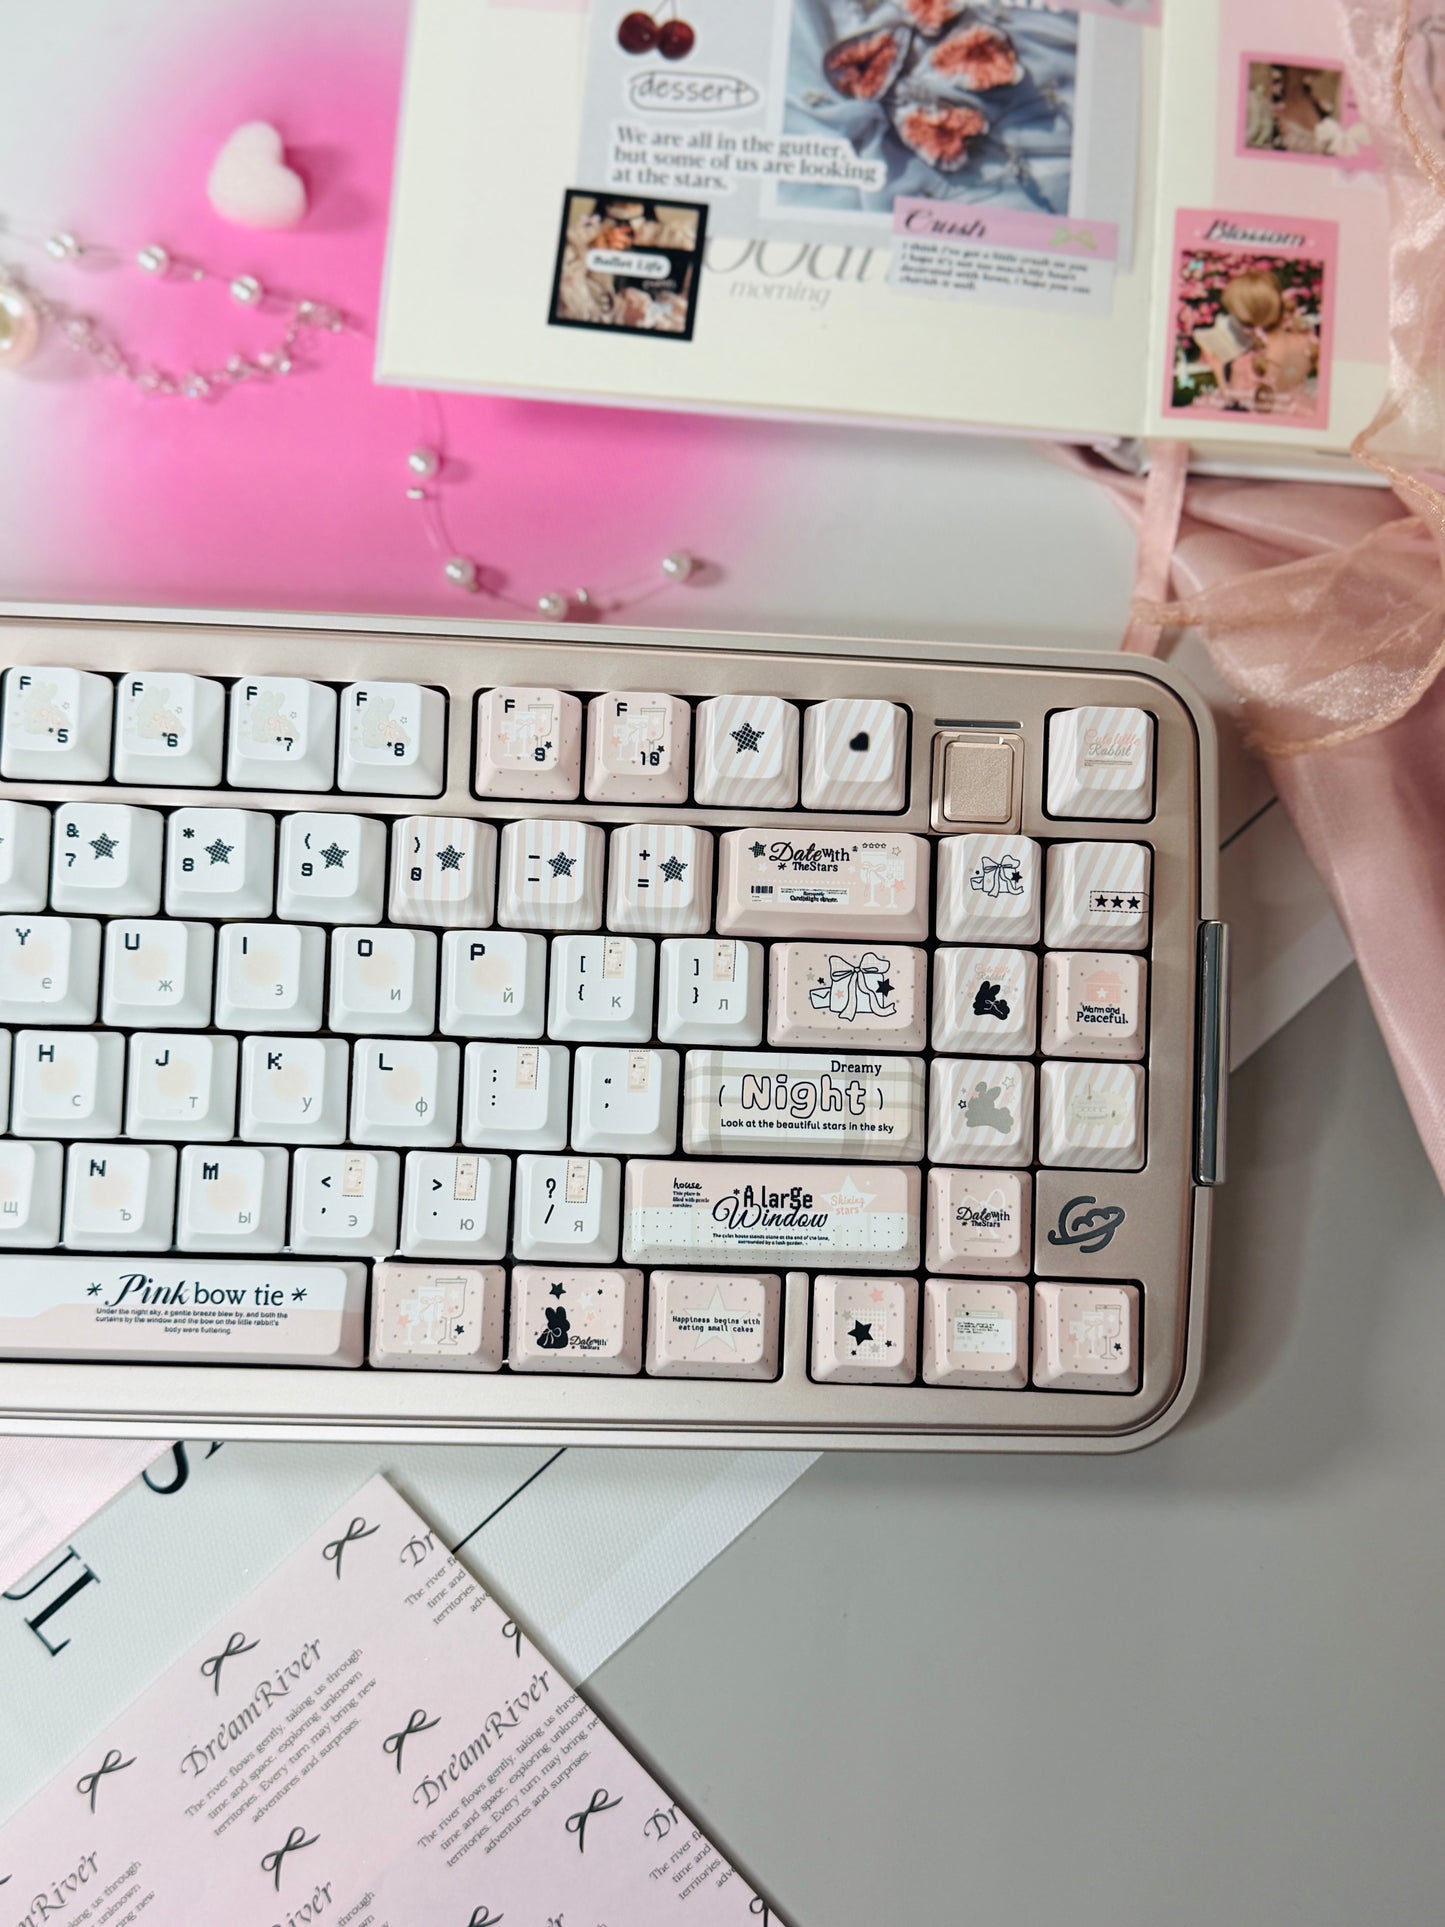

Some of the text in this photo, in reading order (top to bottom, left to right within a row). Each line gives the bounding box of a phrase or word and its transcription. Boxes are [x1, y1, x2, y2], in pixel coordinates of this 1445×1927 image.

[637, 72, 750, 103] dessert
[618, 126, 848, 161] We are all in the gutter,
[614, 146, 878, 183] but some of us are looking
[612, 169, 728, 191] at the stars.
[905, 209, 987, 238] Crush
[1204, 220, 1305, 246] Blossom
[729, 280, 831, 313] morning
[20, 676, 31, 690] F
[132, 682, 143, 696] F
[247, 686, 257, 700] F
[357, 692, 367, 706] F
[505, 699, 515, 713] F
[617, 703, 627, 716] F
[284, 737, 293, 751] 7
[395, 743, 404, 756] 8
[535, 748, 545, 761] 9
[640, 751, 660, 765] 10
[183, 858, 194, 871] 8
[302, 863, 313, 876] 9
[16, 928, 30, 945] Y
[125, 933, 139, 950] U
[243, 937, 247, 954] I
[358, 939, 372, 957] O
[471, 943, 485, 960] P
[1076, 1011, 1128, 1024] Peaceful.
[1082, 1005, 1104, 1013] Warm
[39, 1045, 54, 1062] H
[156, 1050, 169, 1066] J
[268, 1053, 282, 1070] K
[379, 1053, 393, 1070] L
[831, 1060, 882, 1076] Dreamy
[721, 1119, 894, 1133] Look at the beautiful stars in the sky
[90, 1160, 105, 1176] N
[203, 1163, 218, 1180] M
[674, 1177, 702, 1189] house
[761, 1185, 813, 1211] large
[712, 1196, 829, 1230] Window
[104, 1273, 284, 1307] Pink bow tie
[672, 1316, 710, 1324] Happiness
[678, 1324, 704, 1332] eating
[449, 1569, 466, 1589] and
[185, 1799, 206, 1818] The
[206, 1776, 229, 1800] river
[228, 1751, 255, 1777] flows
[286, 1696, 315, 1724] taking
[314, 1684, 326, 1697] us
[326, 1648, 363, 1685] through
[259, 1763, 289, 1792] Every
[289, 1746, 309, 1766] turn
[310, 1722, 332, 1745] may
[331, 1698, 359, 1723] bring
[357, 1678, 377, 1699] new
[207, 1797, 230, 1820] time
[230, 1779, 249, 1799] and
[277, 1712, 322, 1754] exploring
[321, 1670, 362, 1712] unknown
[417, 1829, 438, 1848] The
[438, 1805, 461, 1830] river
[460, 1782, 487, 1808] flows
[516, 1727, 545, 1755] taking
[544, 1714, 556, 1728] us
[490, 1795, 520, 1823] Every
[520, 1775, 540, 1796] turn
[541, 1754, 562, 1777] may
[562, 1730, 589, 1754] bring
[251, 1775, 300, 1823] adventures
[301, 1755, 319, 1777] and
[440, 1828, 461, 1851] time
[462, 1810, 480, 1830] and
[508, 1742, 551, 1784] exploring
[483, 1807, 532, 1854] adventures
[532, 1788, 550, 1808] and
